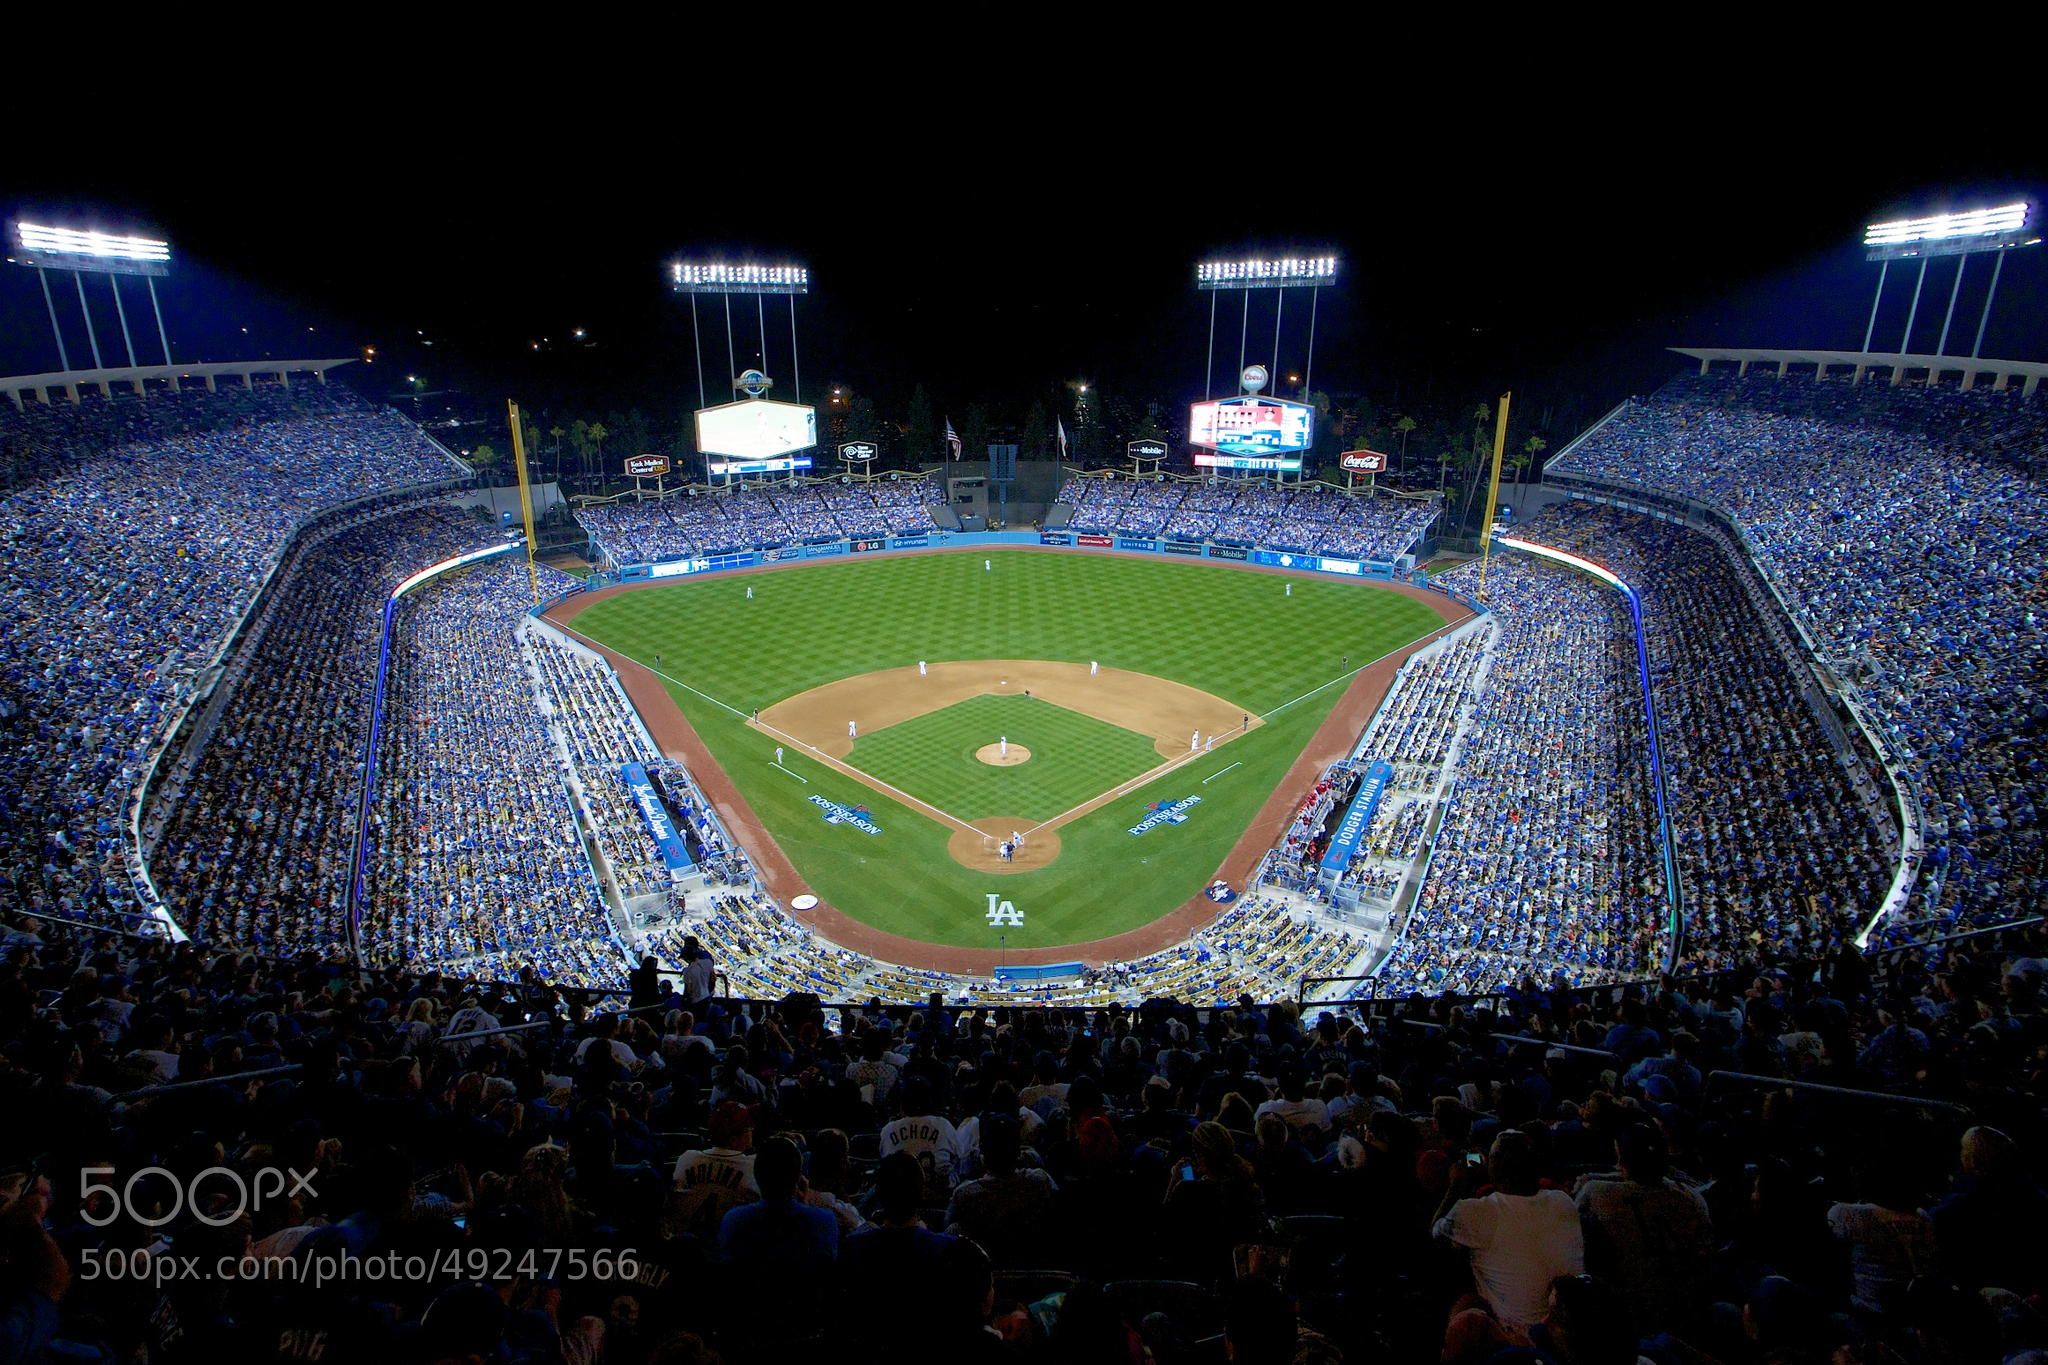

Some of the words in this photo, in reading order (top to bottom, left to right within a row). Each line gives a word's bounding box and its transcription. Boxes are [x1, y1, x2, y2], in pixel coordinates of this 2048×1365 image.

[807, 794, 881, 835] POSTSEASON
[1127, 794, 1201, 835] POSTSEASON
[1337, 811, 1364, 846] DODGER
[1355, 778, 1380, 810] STADIUM
[985, 893, 1025, 926] LA
[890, 1124, 940, 1146] OCHOA
[685, 1160, 744, 1190] MOLINA
